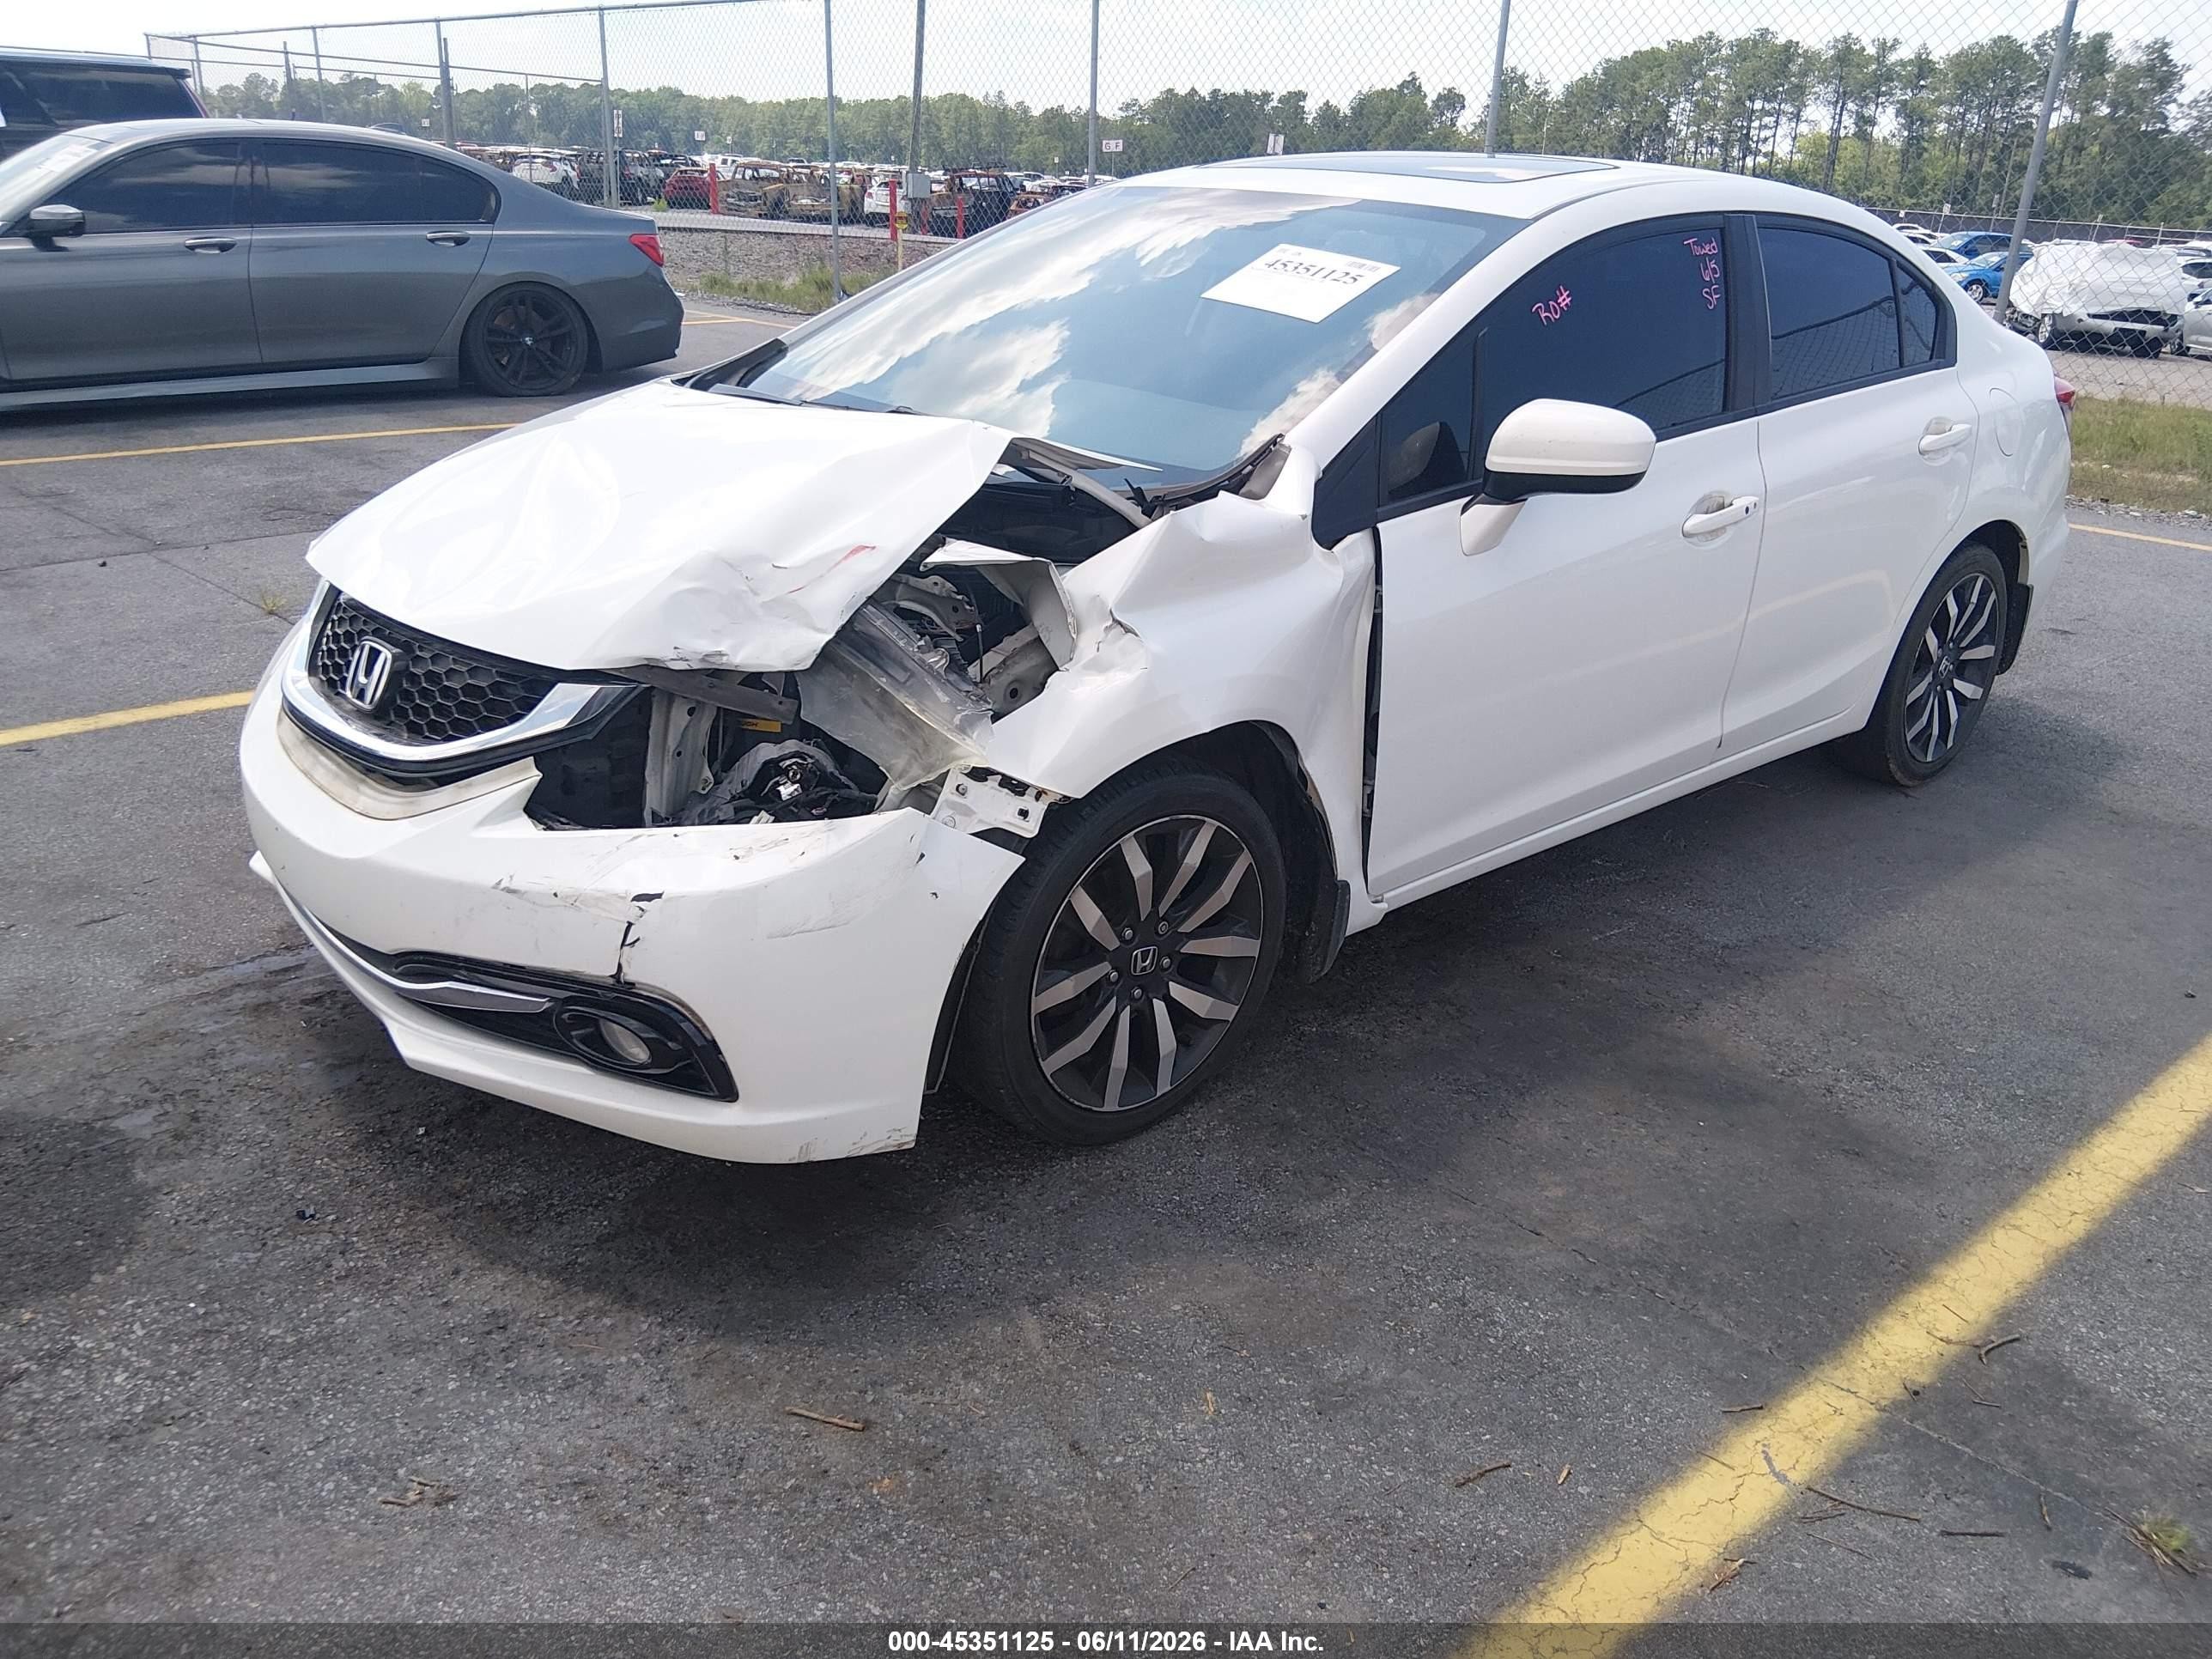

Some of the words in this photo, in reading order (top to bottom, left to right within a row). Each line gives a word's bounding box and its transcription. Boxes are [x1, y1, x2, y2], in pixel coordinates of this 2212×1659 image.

[1683, 237, 1718, 256] Towed
[1264, 258, 1364, 285] 45351125
[1699, 258, 1720, 283] 6/5
[1531, 285, 1572, 326] RO#
[1702, 285, 1722, 310] SF
